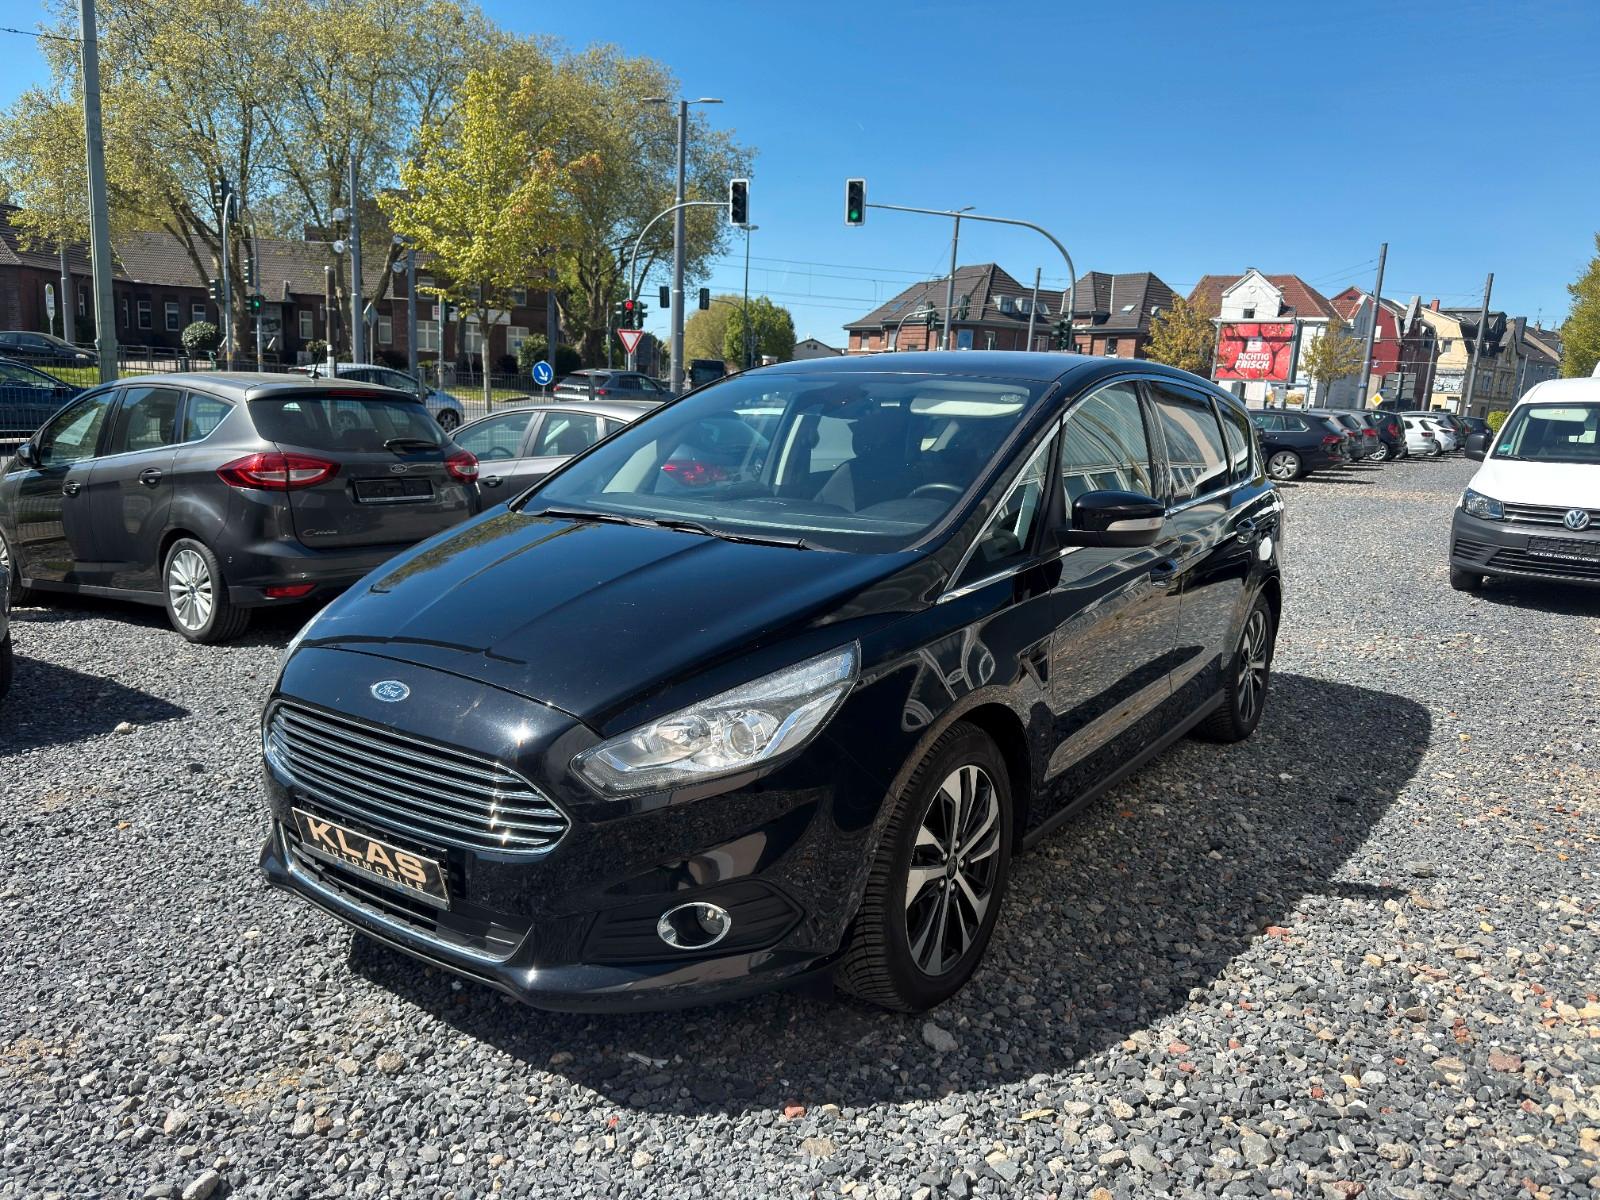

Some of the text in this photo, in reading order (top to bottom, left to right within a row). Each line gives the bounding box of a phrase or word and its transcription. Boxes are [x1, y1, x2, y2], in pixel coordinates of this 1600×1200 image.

[1234, 360, 1270, 370] FRISCH
[1238, 352, 1270, 361] RICHTIG
[307, 816, 427, 884] KLAS
[322, 843, 425, 893] AUTOMOBILE
